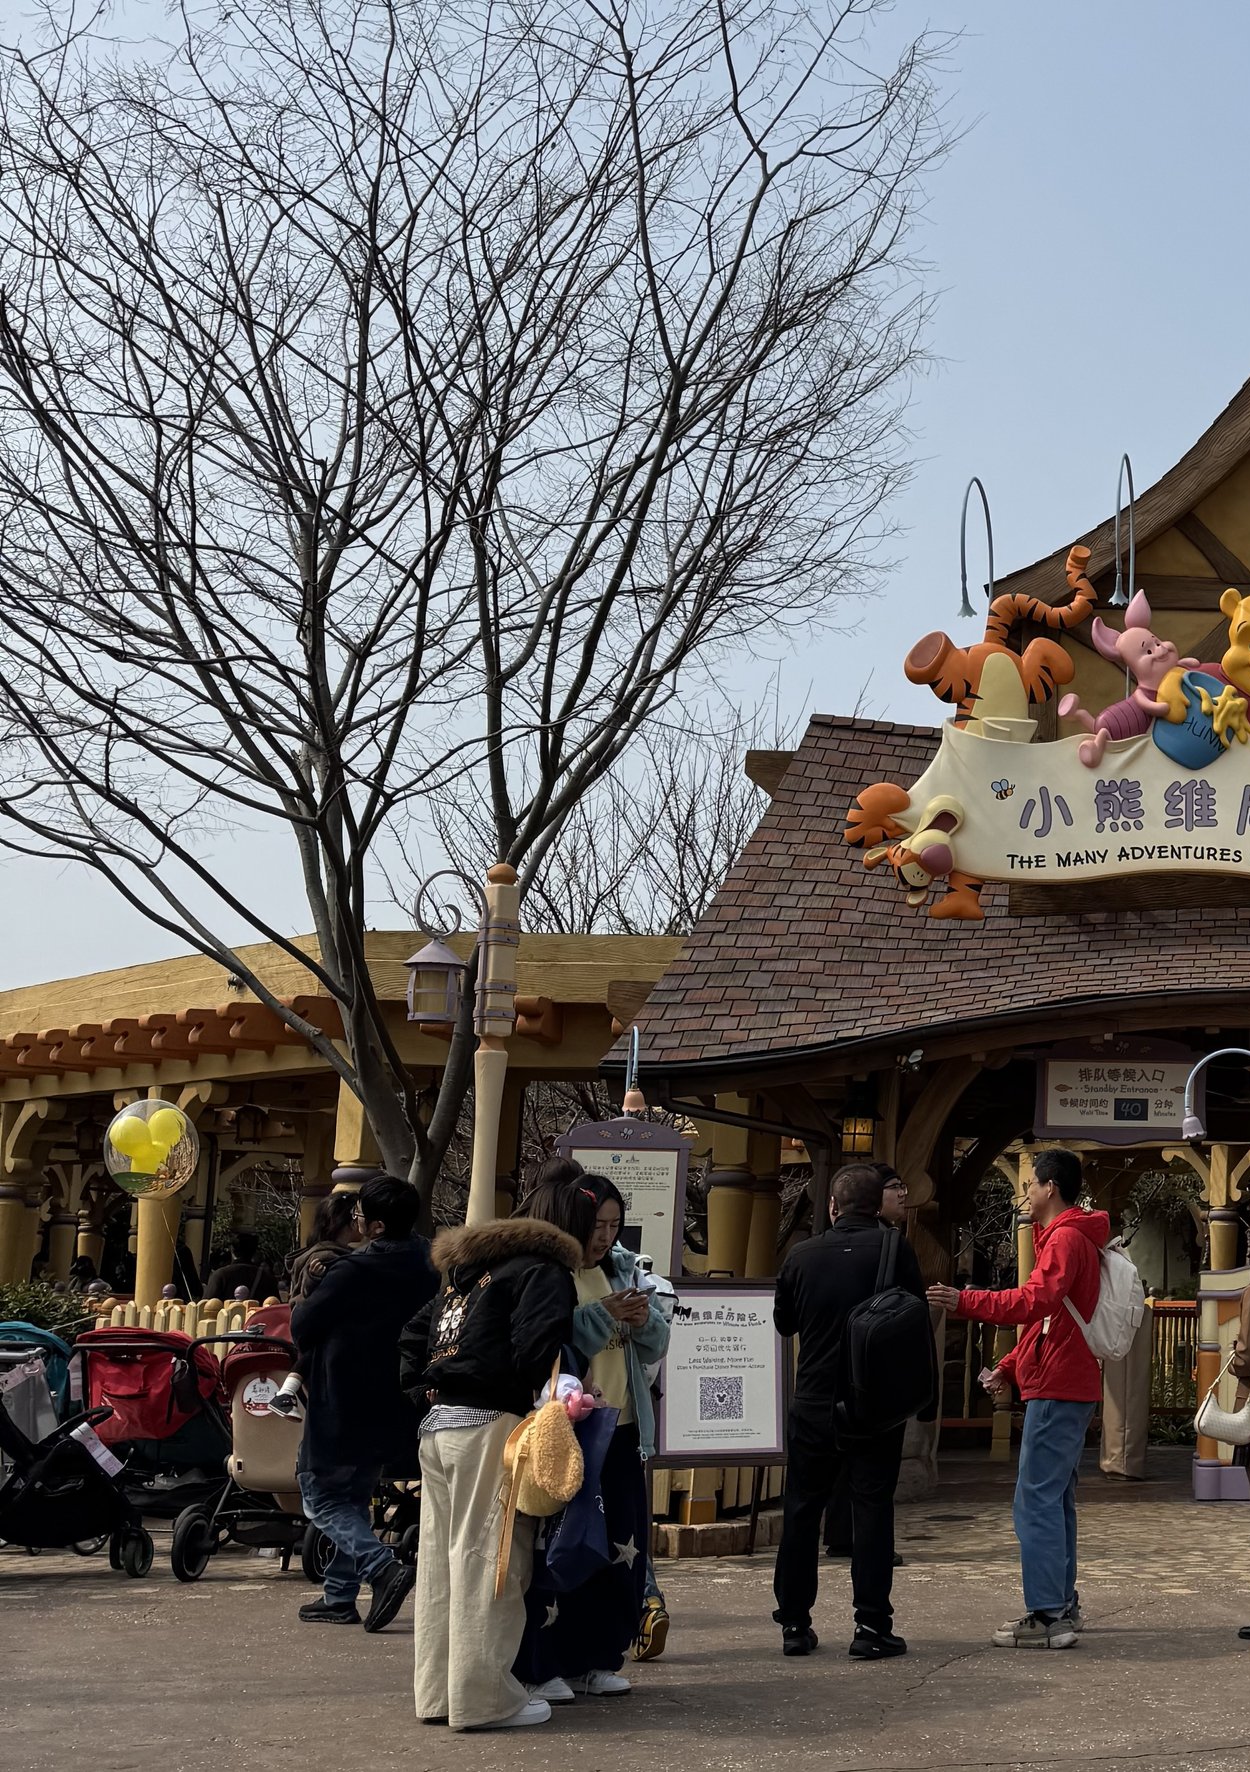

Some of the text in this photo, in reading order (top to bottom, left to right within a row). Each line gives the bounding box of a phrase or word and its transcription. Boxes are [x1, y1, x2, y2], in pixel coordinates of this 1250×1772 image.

[1006, 853, 1047, 870] THE
[1056, 848, 1109, 868] MANY
[1117, 844, 1243, 864] ADVENTURES
[1078, 1067, 1166, 1083] 排队等候入口
[1084, 1084, 1159, 1094] Standby Entrance
[1120, 1101, 1142, 1117] 40
[1154, 1099, 1174, 1110] 分钟
